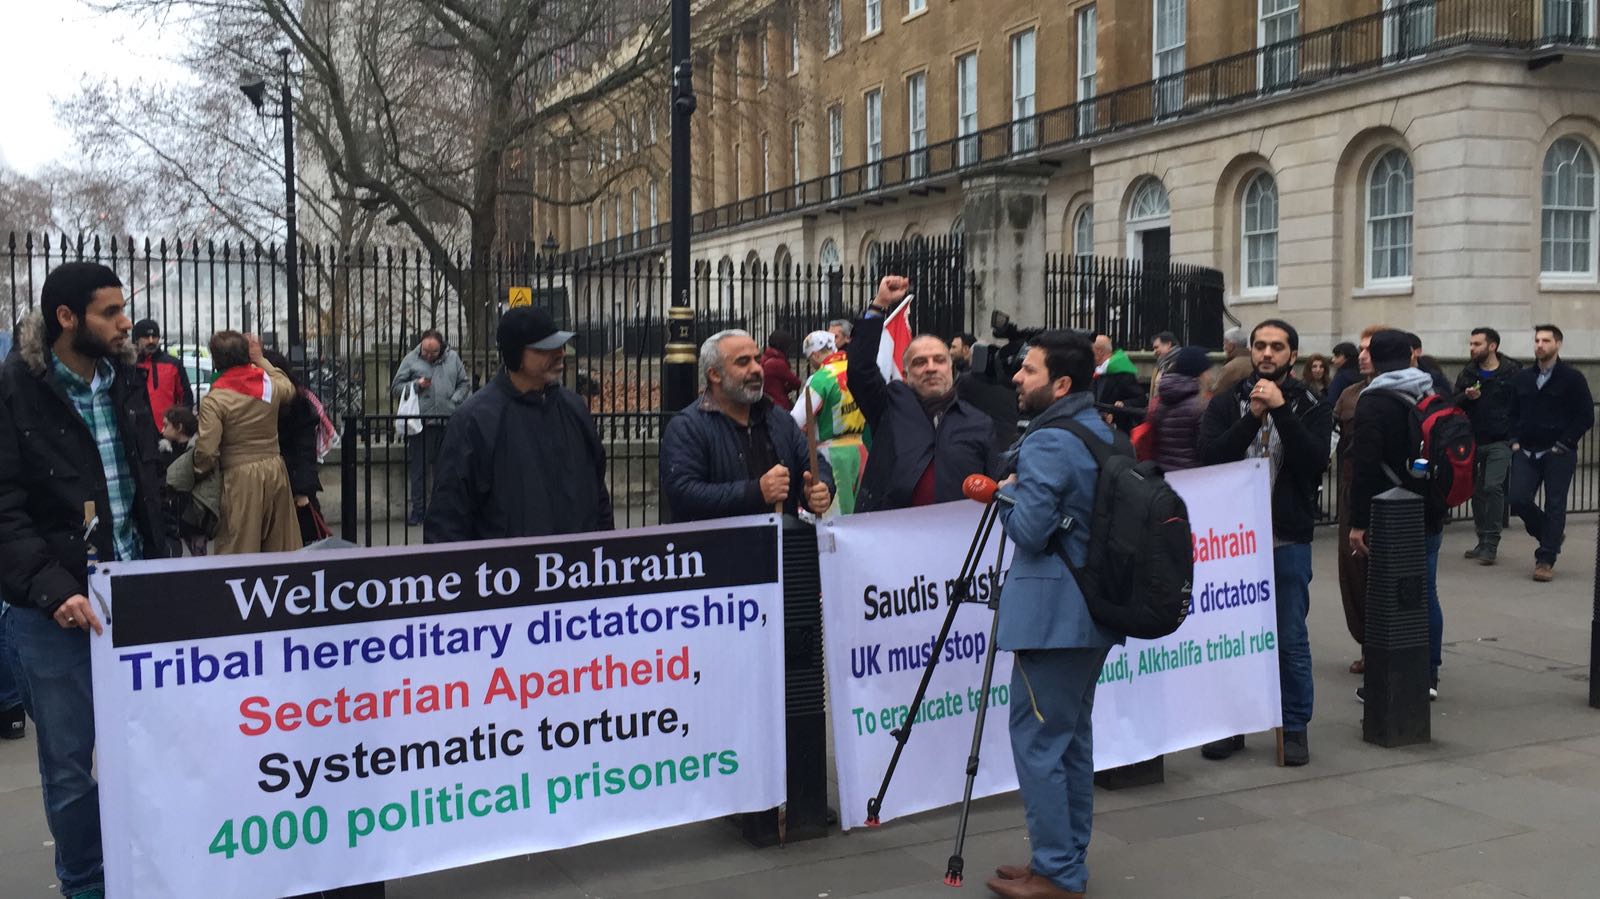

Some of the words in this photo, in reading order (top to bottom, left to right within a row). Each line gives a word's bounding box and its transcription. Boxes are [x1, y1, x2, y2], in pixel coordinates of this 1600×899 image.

[226, 569, 462, 621] Welcome
[474, 562, 521, 597] to
[535, 543, 706, 592] Bahrain
[851, 644, 882, 679] UK
[944, 630, 986, 664] stop
[1200, 577, 1271, 613] dictators
[864, 575, 939, 621] Saudis
[119, 640, 264, 692] Tribal
[283, 622, 513, 661] hereditary
[527, 593, 768, 645] dictatorship,
[852, 707, 877, 736] To
[967, 684, 1011, 713] tero
[1097, 652, 1134, 684] audi,
[1138, 638, 1203, 676] Alkhalifa
[1206, 630, 1246, 663] tribal
[239, 676, 470, 736] Sectarian
[484, 646, 702, 708] Apartheid,
[257, 724, 525, 799] Systematic
[537, 706, 690, 752] torture,
[207, 804, 329, 861] 4000
[346, 772, 532, 849] political
[545, 750, 741, 815] prisoners
